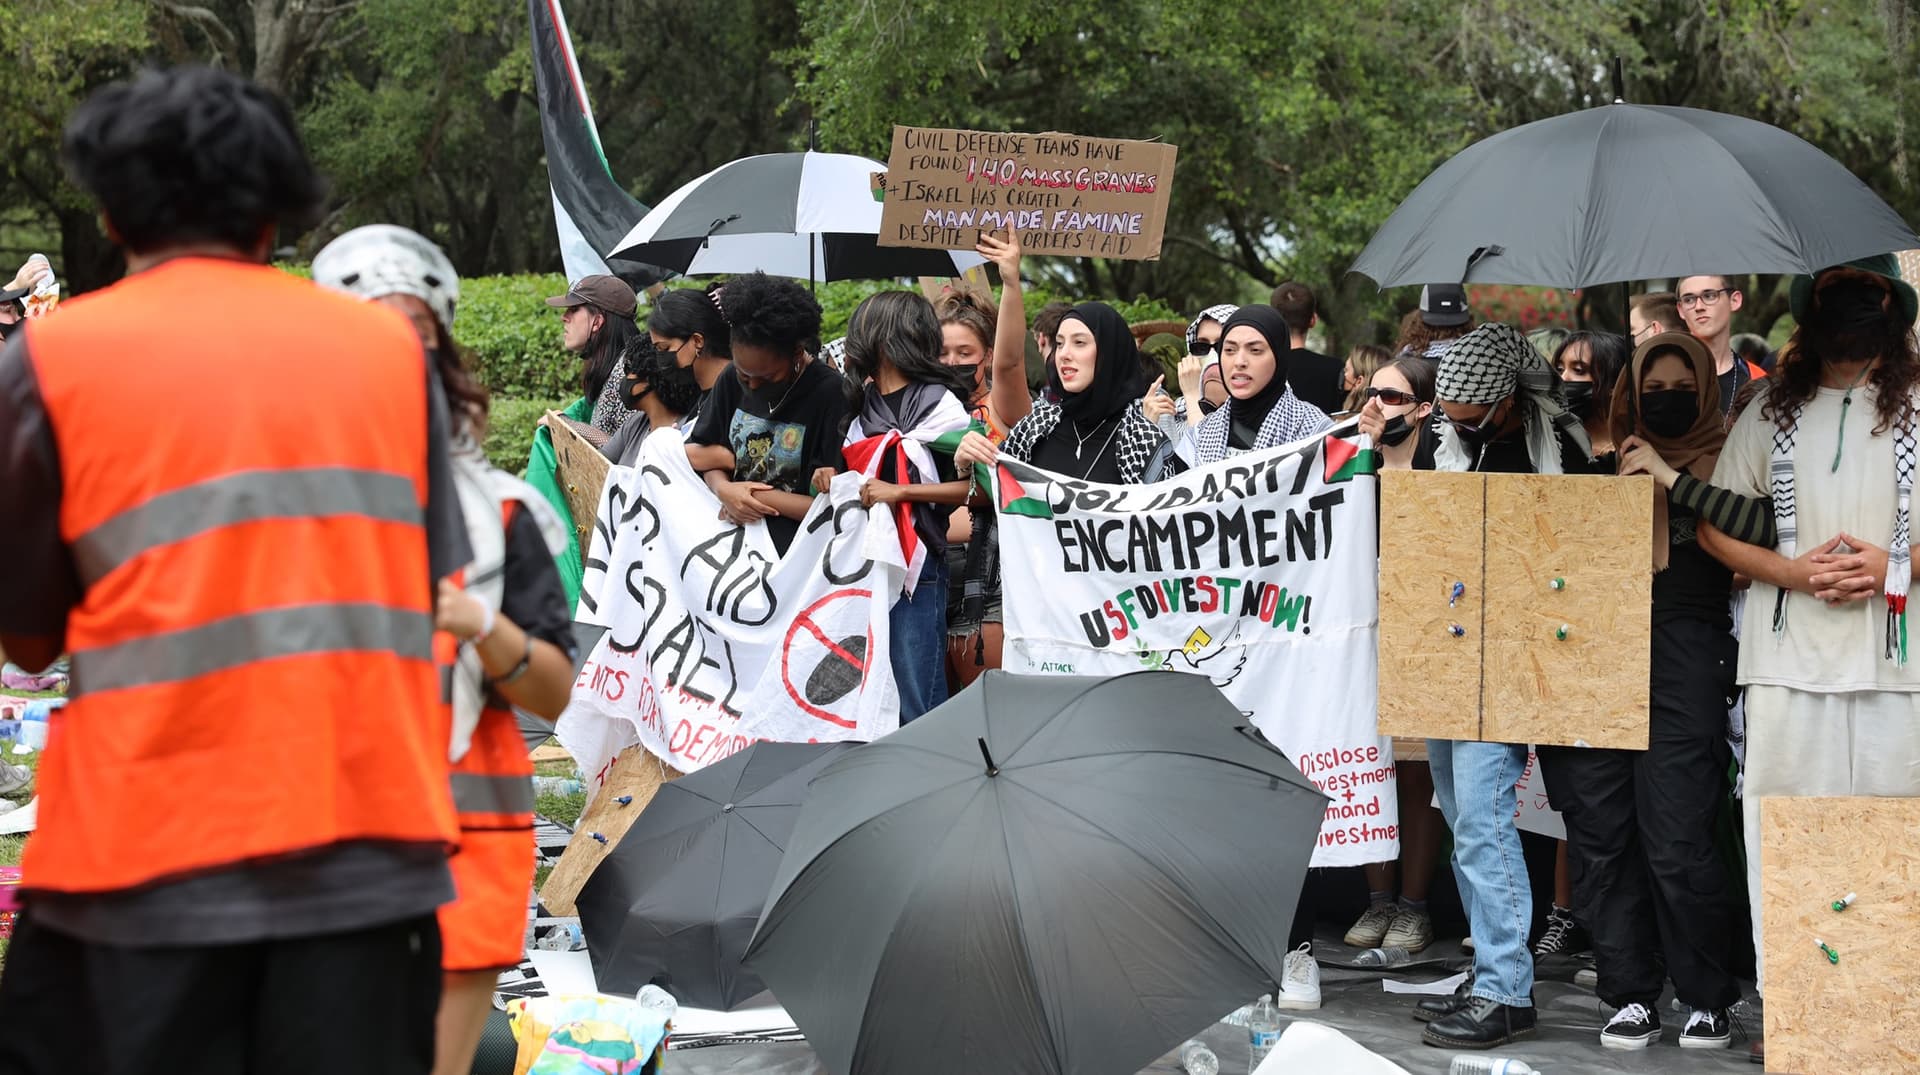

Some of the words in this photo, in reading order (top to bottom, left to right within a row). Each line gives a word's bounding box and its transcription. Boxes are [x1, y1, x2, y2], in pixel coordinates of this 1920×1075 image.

[905, 128, 949, 151] CIVIL
[956, 132, 1028, 157] DEFENSE
[1034, 137, 1081, 157] TEAMS
[1085, 142, 1126, 161] HAVE
[909, 154, 963, 171] FOUND
[966, 155, 1017, 186] 140
[1074, 165, 1158, 194] GRAVES
[899, 179, 965, 203] ISRAEL
[971, 185, 997, 206] HAS
[1006, 188, 1063, 208] CREATED
[1071, 194, 1083, 208] A
[922, 206, 978, 228] MAN
[979, 207, 1045, 231] MADE
[1050, 208, 1144, 236] FAMINE
[899, 223, 964, 246] DESPITE
[1022, 231, 1084, 249] ORDERS
[1086, 232, 1097, 250] 4
[1100, 234, 1132, 255] AID
[1051, 441, 1321, 515] SOLIDARITY
[1054, 487, 1345, 573] ENCAMPMENT
[1300, 745, 1379, 778] Disclose
[1311, 761, 1396, 792] vestment
[1325, 794, 1380, 821] mand
[1318, 821, 1400, 848] ivestme
